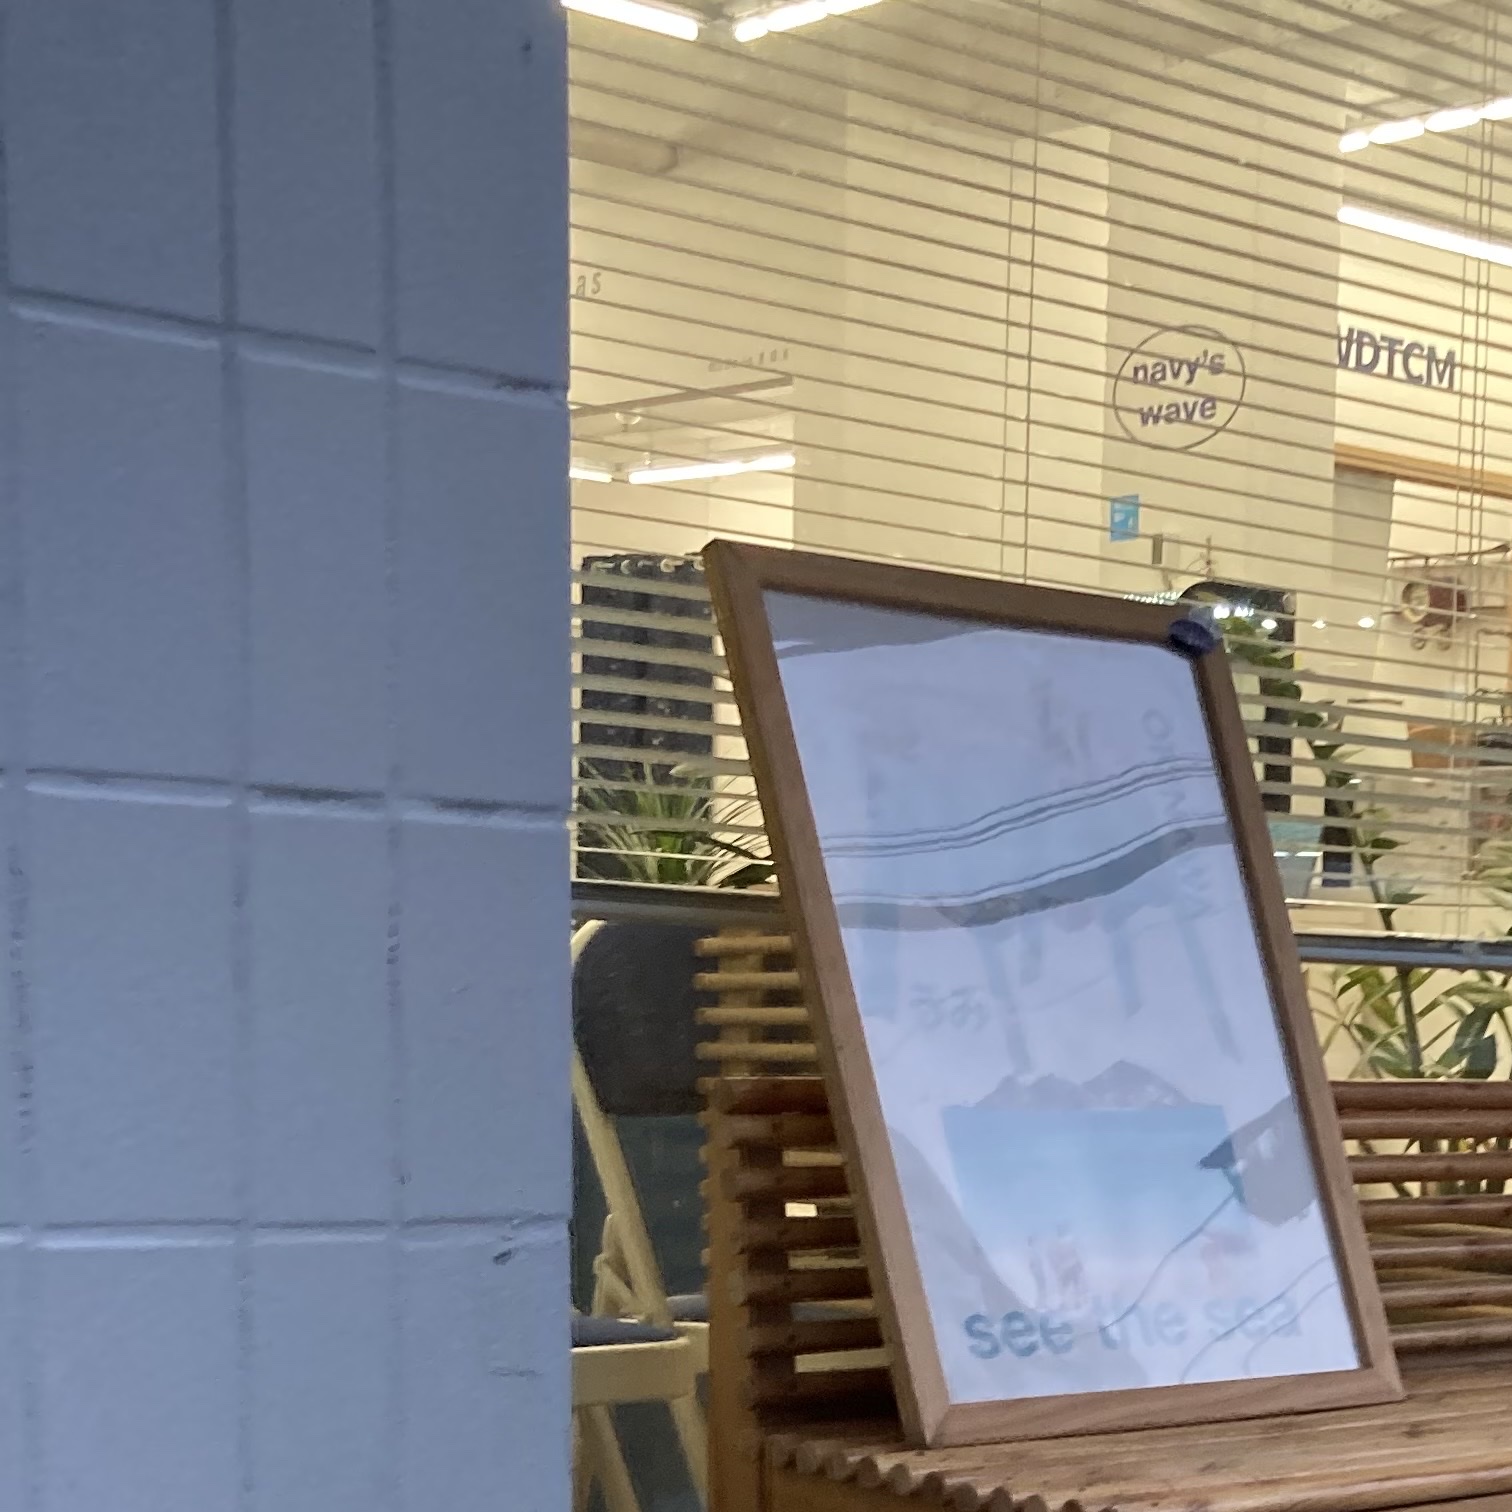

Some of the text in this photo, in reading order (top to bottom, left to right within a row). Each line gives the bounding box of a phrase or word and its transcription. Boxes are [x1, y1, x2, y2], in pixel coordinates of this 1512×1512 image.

[1132, 349, 1225, 385] navy's
[1139, 396, 1217, 425] wave
[962, 1309, 1075, 1360] see
